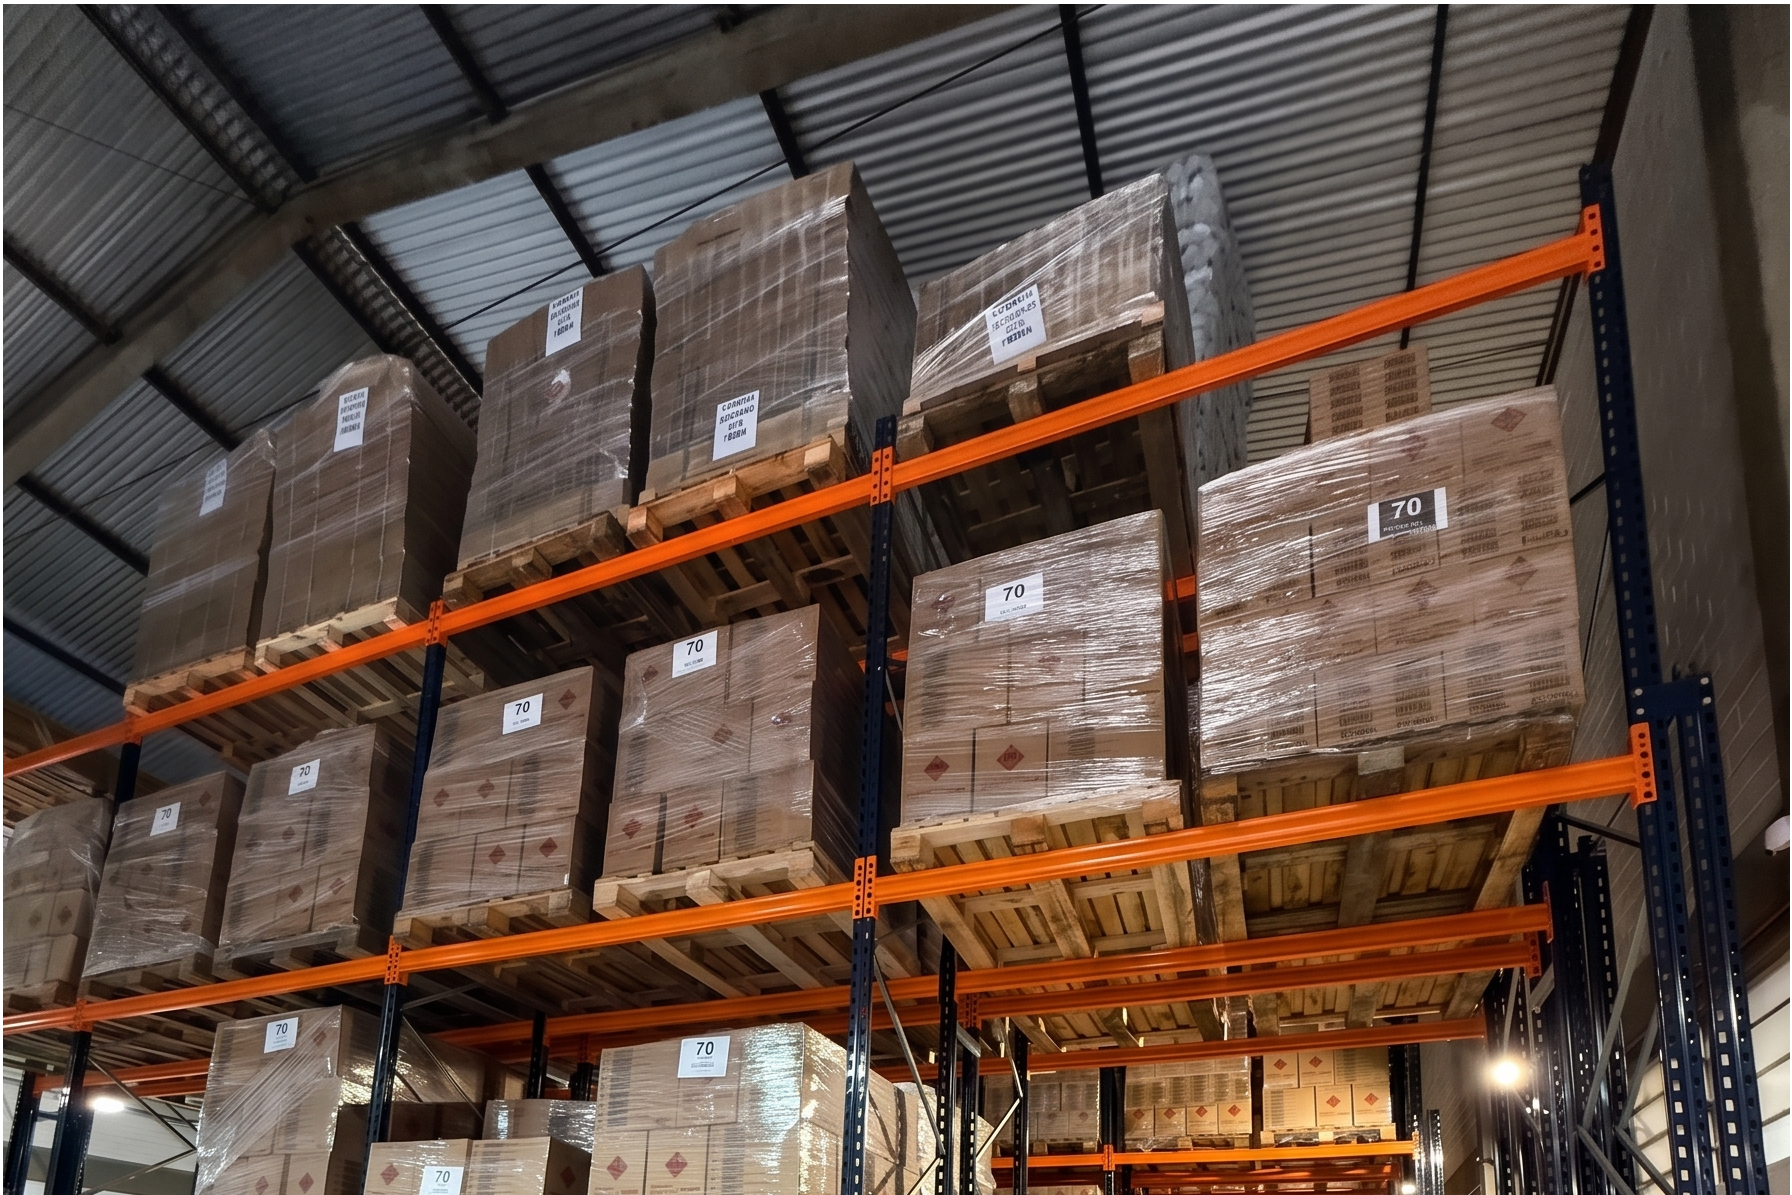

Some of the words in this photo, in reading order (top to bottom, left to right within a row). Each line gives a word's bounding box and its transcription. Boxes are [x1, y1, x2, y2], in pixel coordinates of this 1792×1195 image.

[1391, 497, 1422, 519] 70
[1002, 584, 1025, 601] 70
[686, 639, 704, 656] 70
[515, 701, 531, 715] 70
[299, 765, 311, 777] 70
[161, 808, 172, 820] 70
[276, 1023, 288, 1035] 70
[696, 1041, 714, 1056] 70
[435, 1170, 451, 1183] 70
